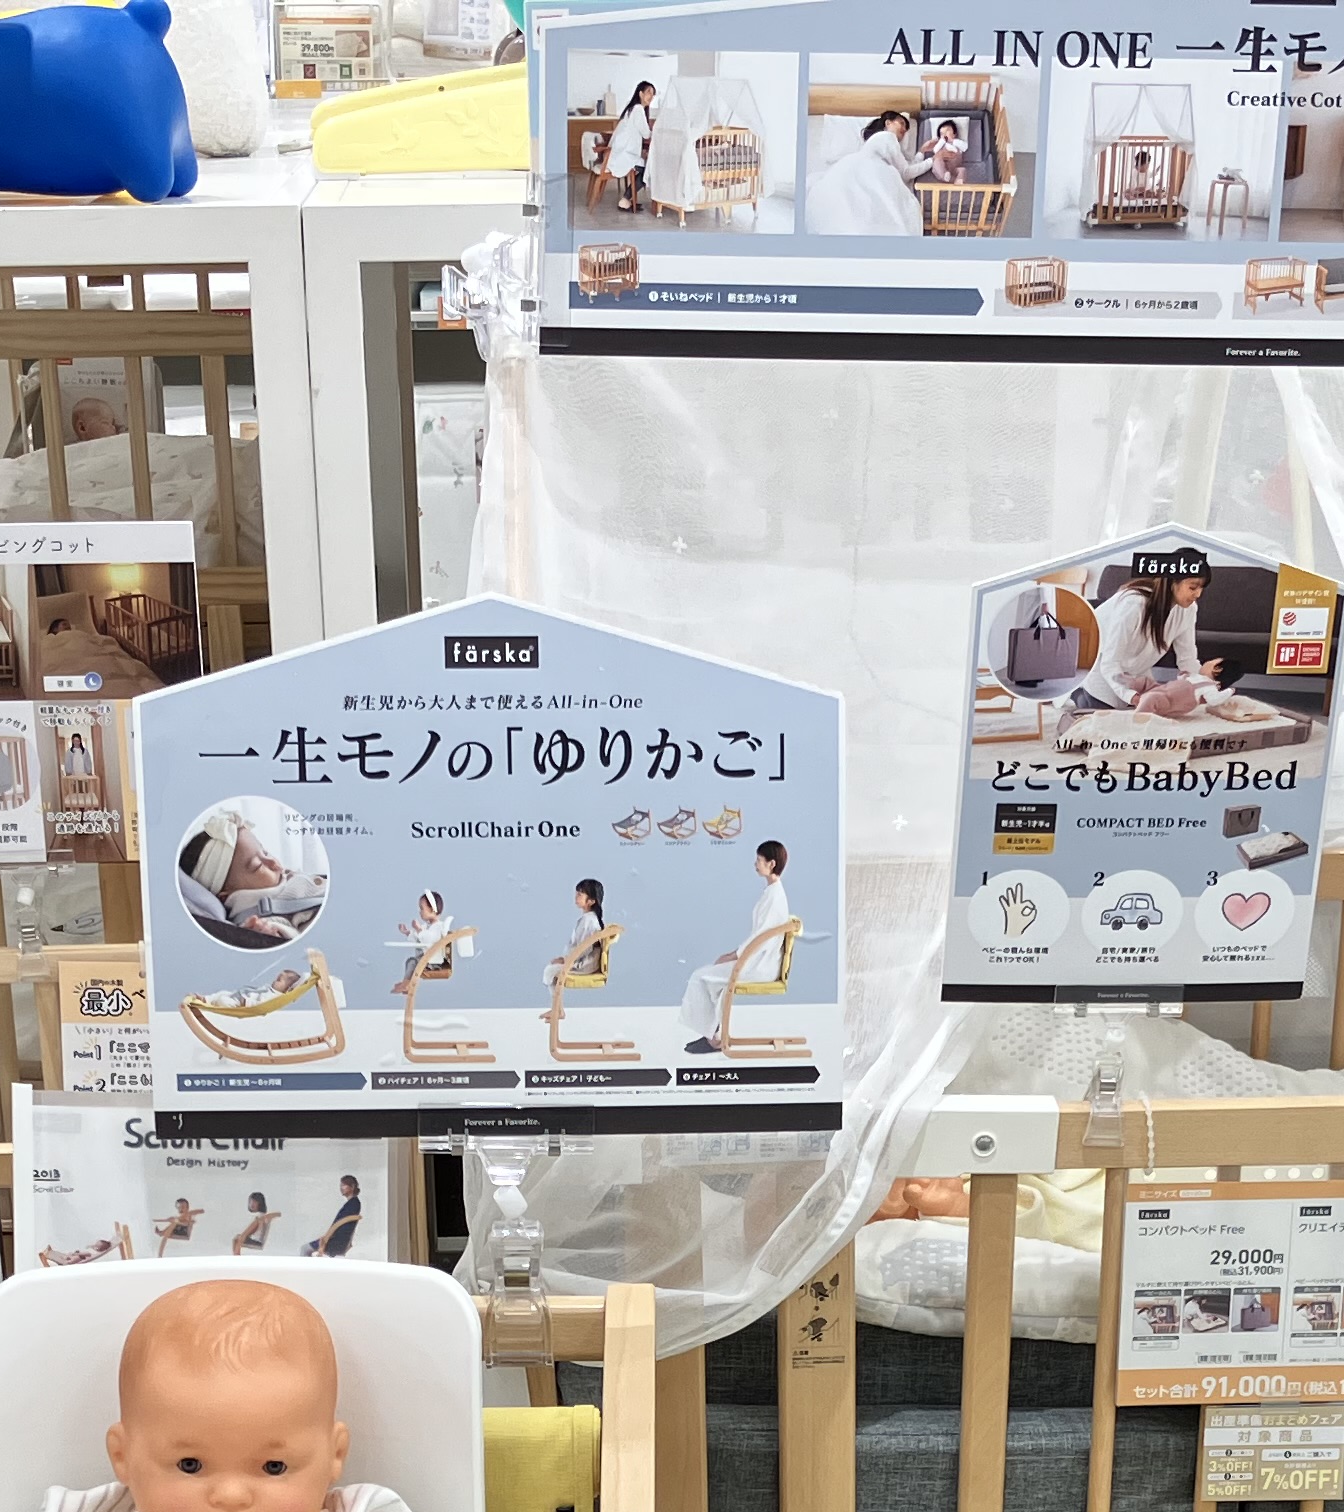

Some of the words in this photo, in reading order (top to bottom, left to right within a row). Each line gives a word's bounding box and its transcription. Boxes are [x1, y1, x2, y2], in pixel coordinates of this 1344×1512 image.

[883, 27, 976, 66] ALL
[992, 29, 1044, 68] IN
[1056, 31, 1154, 69] ONE
[1227, 91, 1307, 108] Creative
[1311, 92, 1342, 108] Cot
[1086, 299, 1121, 309] サークル
[1225, 347, 1256, 356] Forever
[1137, 557, 1202, 575] färska
[452, 641, 533, 664] färska
[342, 692, 644, 713] 新生児から大人まで使えるAll-in-One
[197, 726, 788, 786] 一生モノの「ゆりかご」
[991, 758, 1297, 797] どこでもBabyBed
[411, 820, 534, 840] ScrollChair
[537, 821, 580, 839] One
[1076, 817, 1144, 829] COMPACT
[1147, 818, 1174, 829] BED
[1177, 818, 1207, 829] Free
[980, 871, 989, 887] 1
[1092, 871, 1105, 887] 2
[1206, 870, 1219, 887] 3
[1095, 955, 1160, 964] どこでも持ち運べる
[73, 1050, 94, 1059] Point
[387, 1076, 419, 1086] ハイチェア
[540, 1074, 578, 1083] キッズチェア
[691, 1073, 713, 1081] チェア
[94, 1078, 106, 1093] 2
[464, 1117, 496, 1127] Forever
[166, 1156, 203, 1168] Design
[207, 1156, 250, 1170] History
[1138, 1190, 1177, 1199] ミニサイズ
[1138, 1225, 1217, 1237] コンパクトベッド
[1220, 1224, 1245, 1235] Free
[1209, 1248, 1284, 1265] 29,000円
[1219, 1265, 1284, 1277] (税込31,900円)
[1133, 1383, 1199, 1399] セット合計
[1201, 1375, 1302, 1399] 91,000円
[1237, 1429, 1313, 1443] 対象商品
[1208, 1460, 1253, 1473] 3%OFF!
[1260, 1467, 1340, 1491] 7%OFF!
[1207, 1484, 1252, 1496] 5%OFF!
